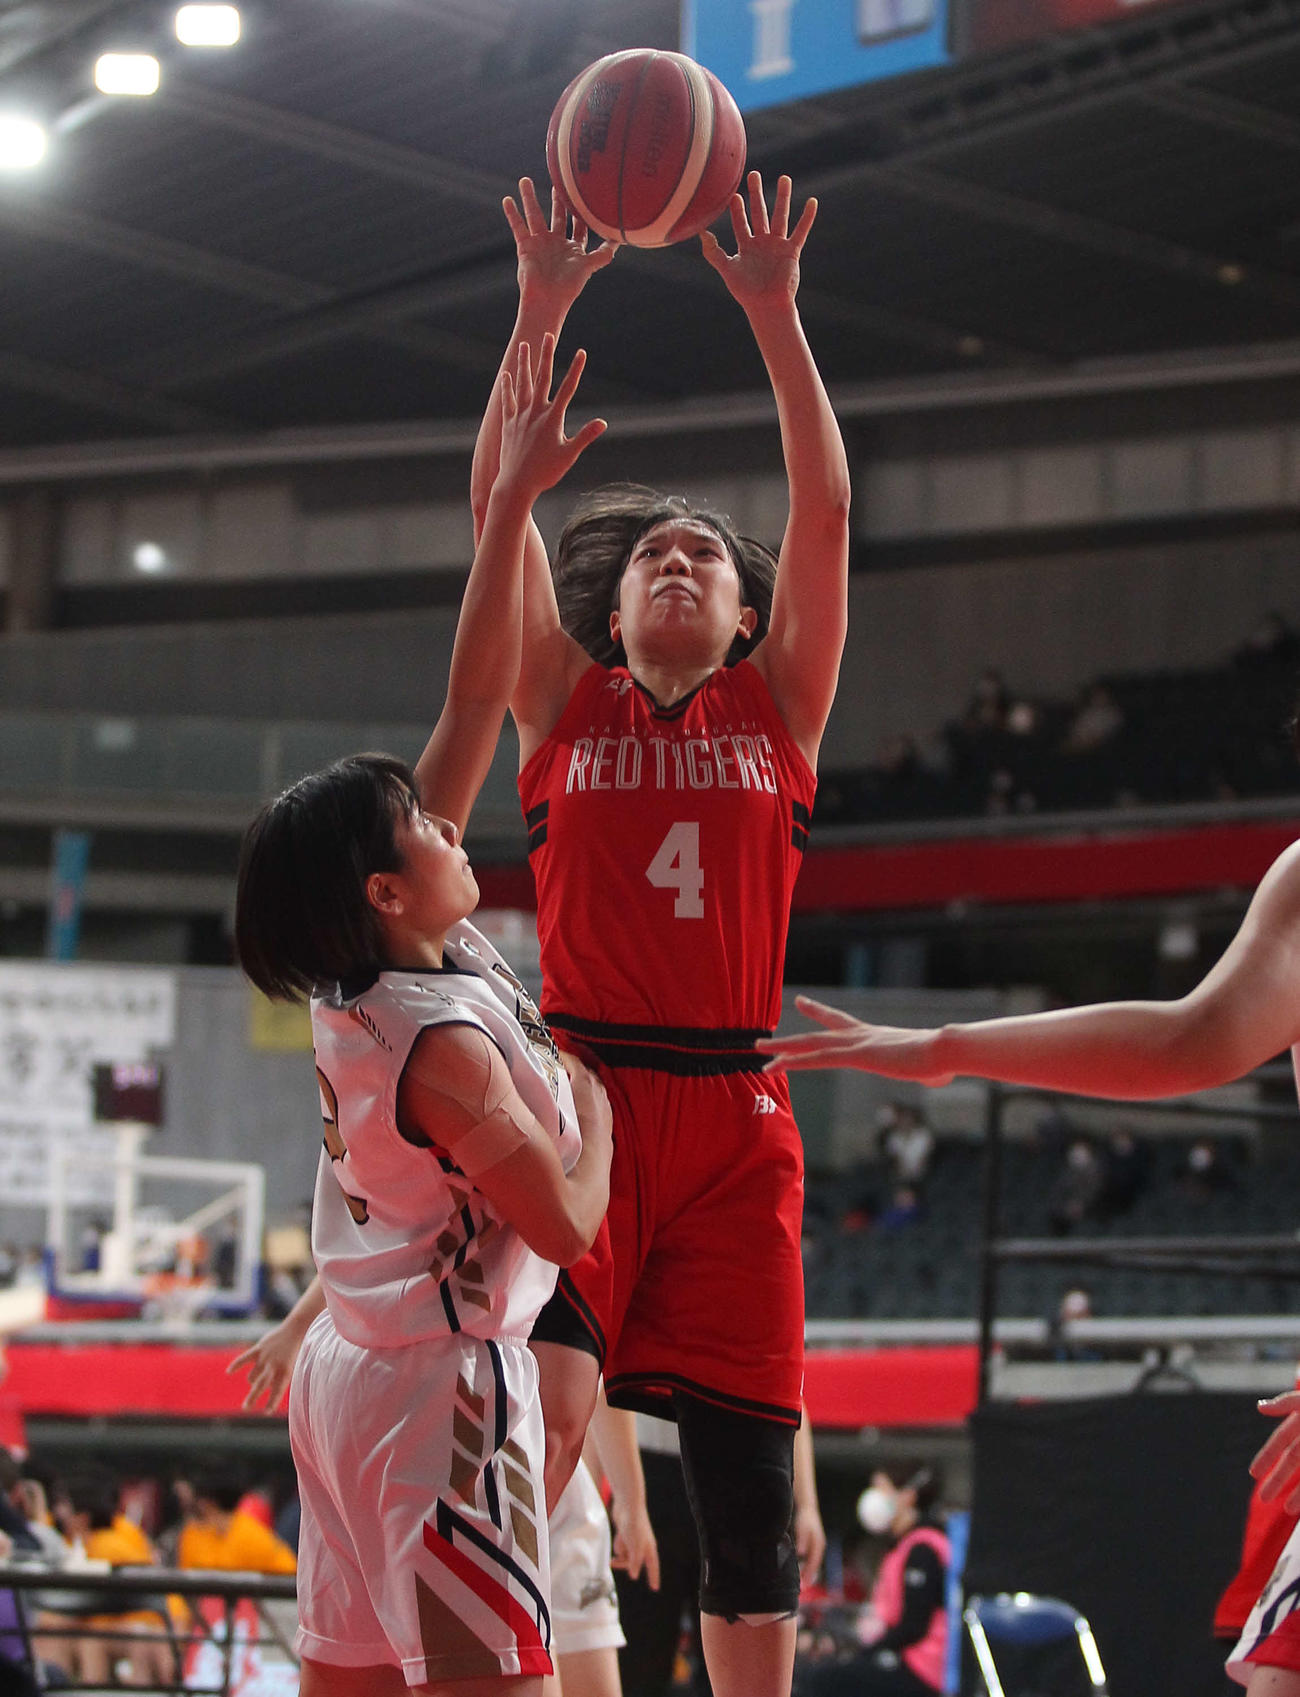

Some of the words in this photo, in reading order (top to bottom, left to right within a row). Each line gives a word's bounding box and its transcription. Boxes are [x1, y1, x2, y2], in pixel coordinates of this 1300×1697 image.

[565, 735, 643, 795] RED
[648, 734, 778, 796] TIGERS
[645, 821, 705, 919] 4
